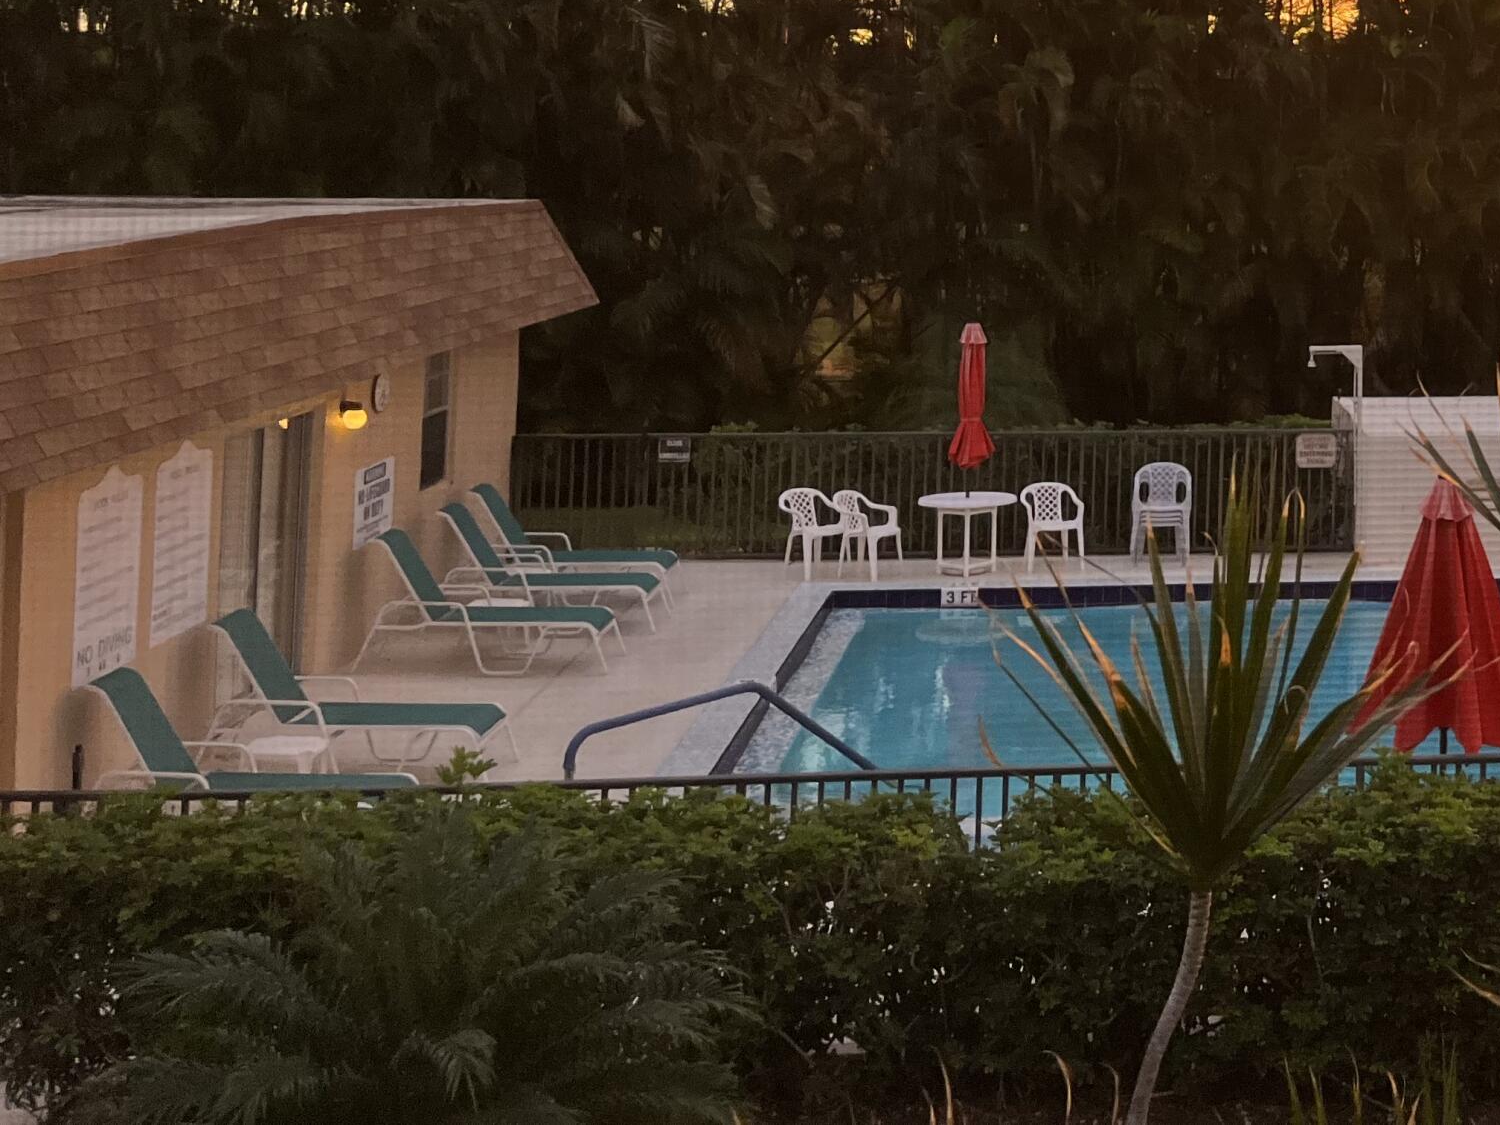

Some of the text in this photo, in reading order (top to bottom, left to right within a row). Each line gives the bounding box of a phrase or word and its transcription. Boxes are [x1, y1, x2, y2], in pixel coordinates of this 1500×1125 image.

[946, 590, 955, 604] 3
[77, 645, 93, 667] NO
[98, 626, 133, 658] DIVING
